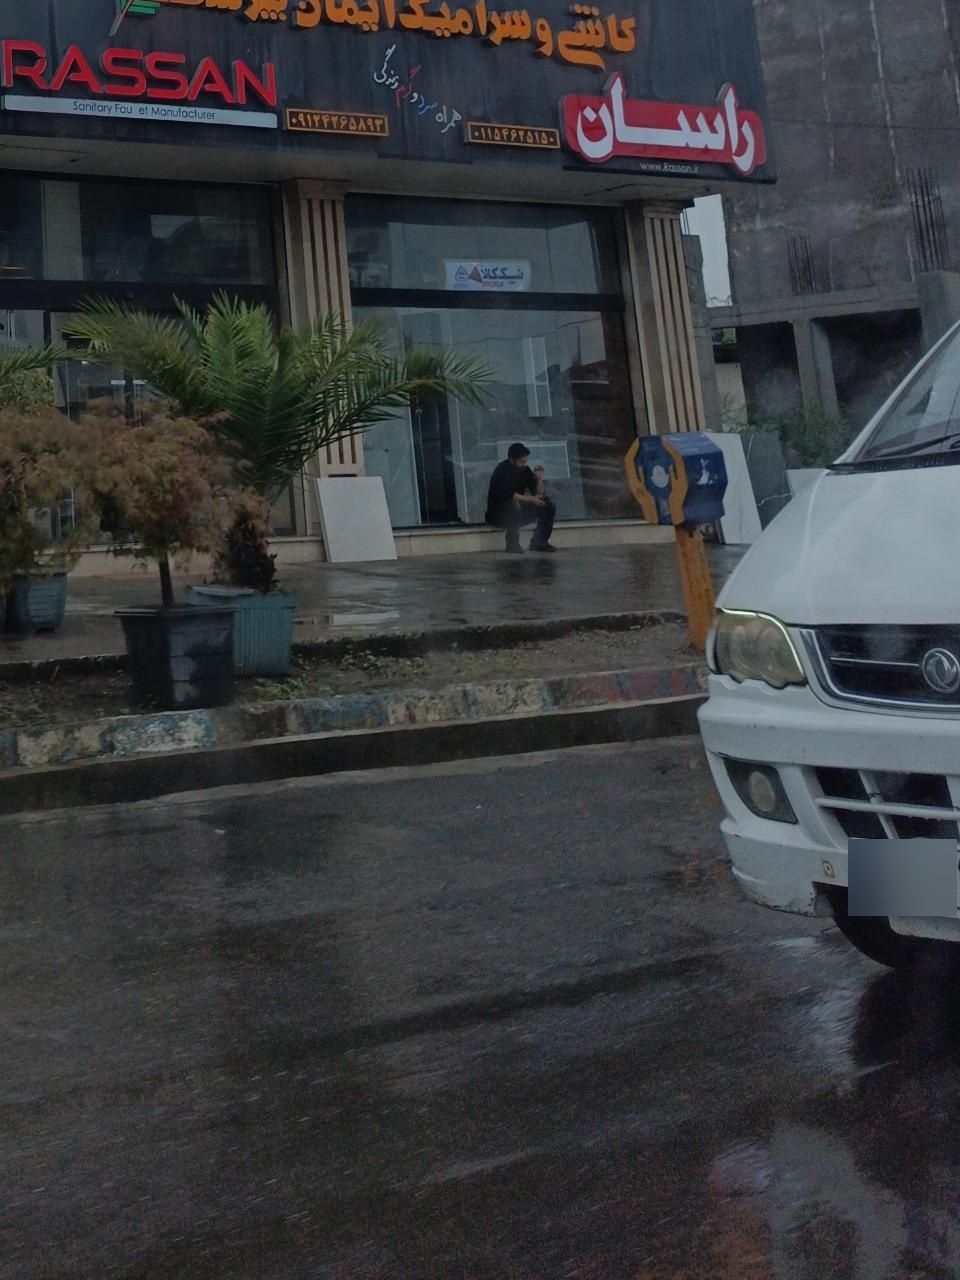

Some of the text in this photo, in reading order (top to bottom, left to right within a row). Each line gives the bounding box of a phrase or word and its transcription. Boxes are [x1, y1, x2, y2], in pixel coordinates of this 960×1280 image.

[535, 17, 554, 57] و
[557, 3, 636, 70] کاشی
[1, 39, 278, 107] RASSAN
[73, 100, 113, 115] Sanitary
[151, 106, 216, 121] Manufacturer
[435, 104, 462, 133] همراه
[577, 76, 755, 171] راسان
